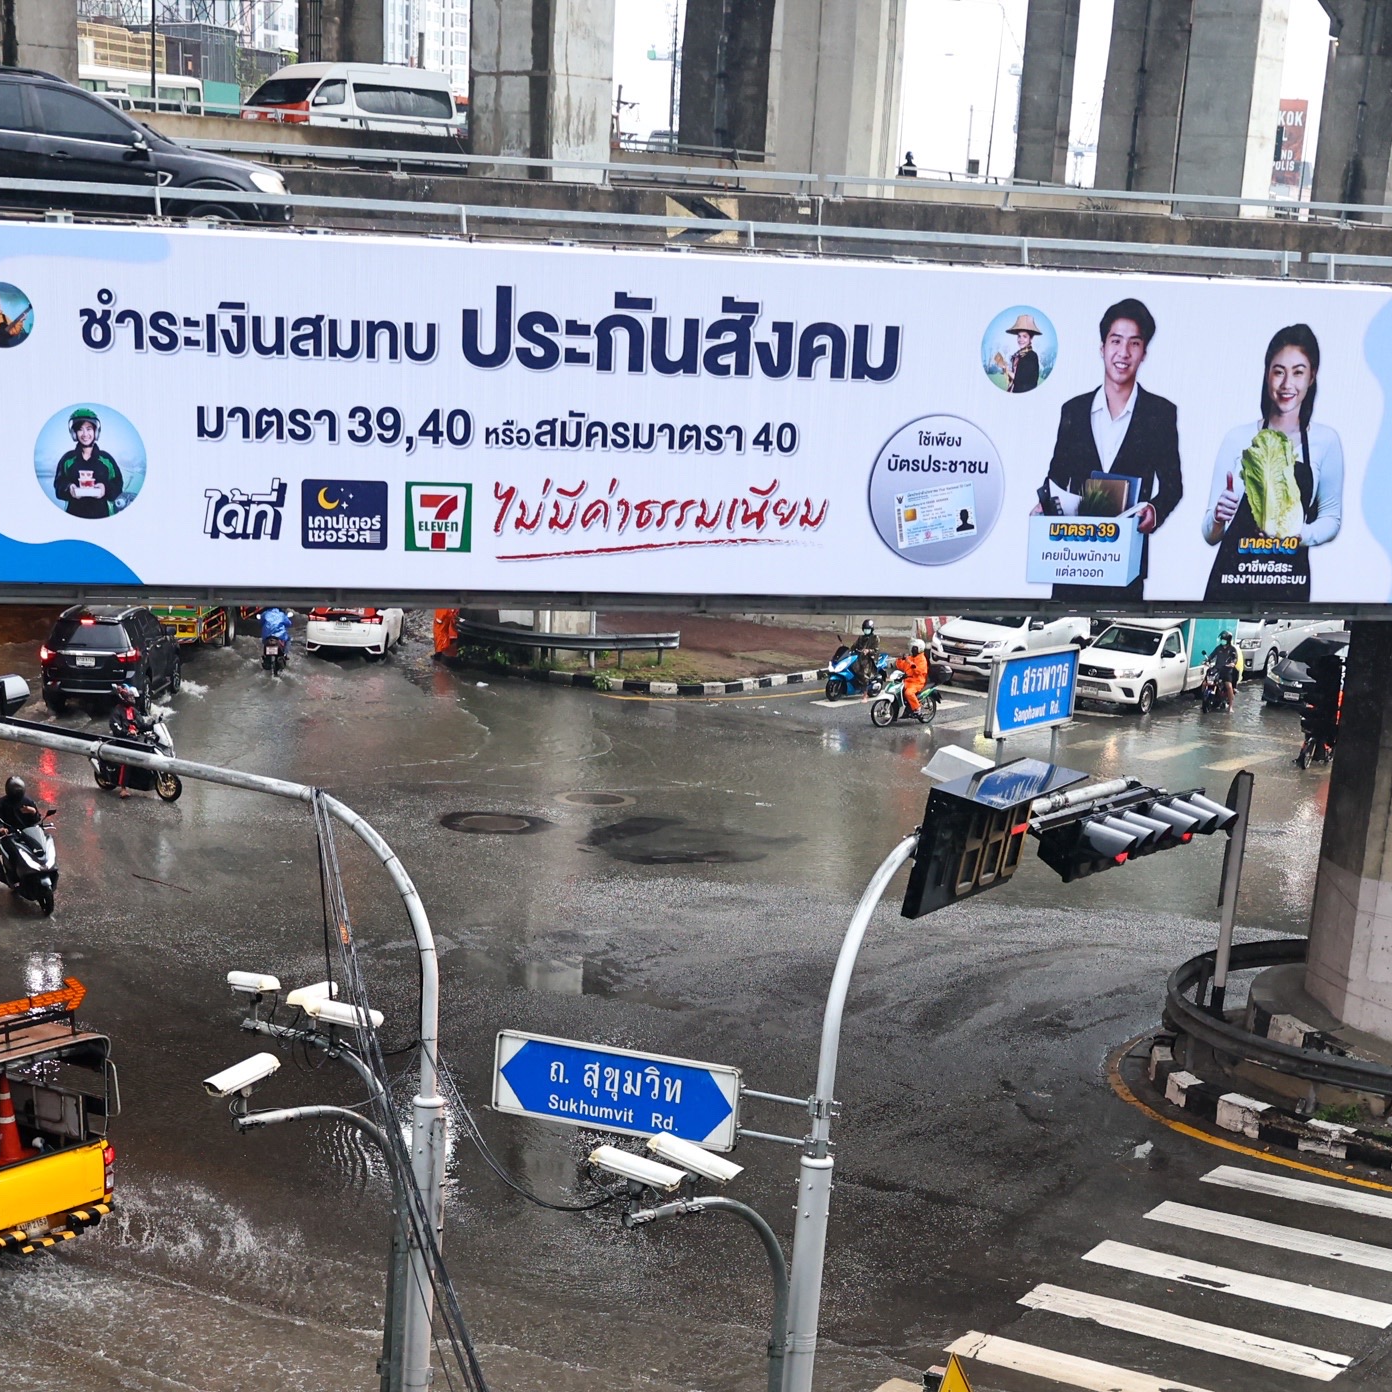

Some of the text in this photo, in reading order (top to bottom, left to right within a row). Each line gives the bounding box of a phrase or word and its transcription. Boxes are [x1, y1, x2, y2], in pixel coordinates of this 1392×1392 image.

[79, 285, 901, 382] ชำระเงินสมทบ ประกันสังคม
[196, 405, 338, 443] มาตรา
[347, 405, 472, 453] 39,40
[752, 422, 798, 454] 40
[918, 431, 962, 447] ใช้เพียง
[888, 454, 989, 474] บัตรประชาชน
[204, 478, 287, 540] ได้ที่
[493, 477, 828, 534] ไม่มีค่าธรรมเนียม
[1050, 523, 1116, 537] มาตรา 39
[1239, 537, 1298, 549] มาตรา 40
[1041, 547, 1121, 562] เคยเป็นพนักงาน
[1055, 565, 1104, 578] แต่ลาออก
[1238, 560, 1293, 573] อาชีพอิสระ
[1221, 574, 1307, 585] แรงงานนอกระบบ
[1010, 663, 1070, 698] ถ. สรรพาวุธ
[1013, 700, 1060, 724] Sanphawut Rd.
[550, 1060, 683, 1104] ถ. สุขุมวิท
[548, 1093, 679, 1132] Sukhumvit Rd.
